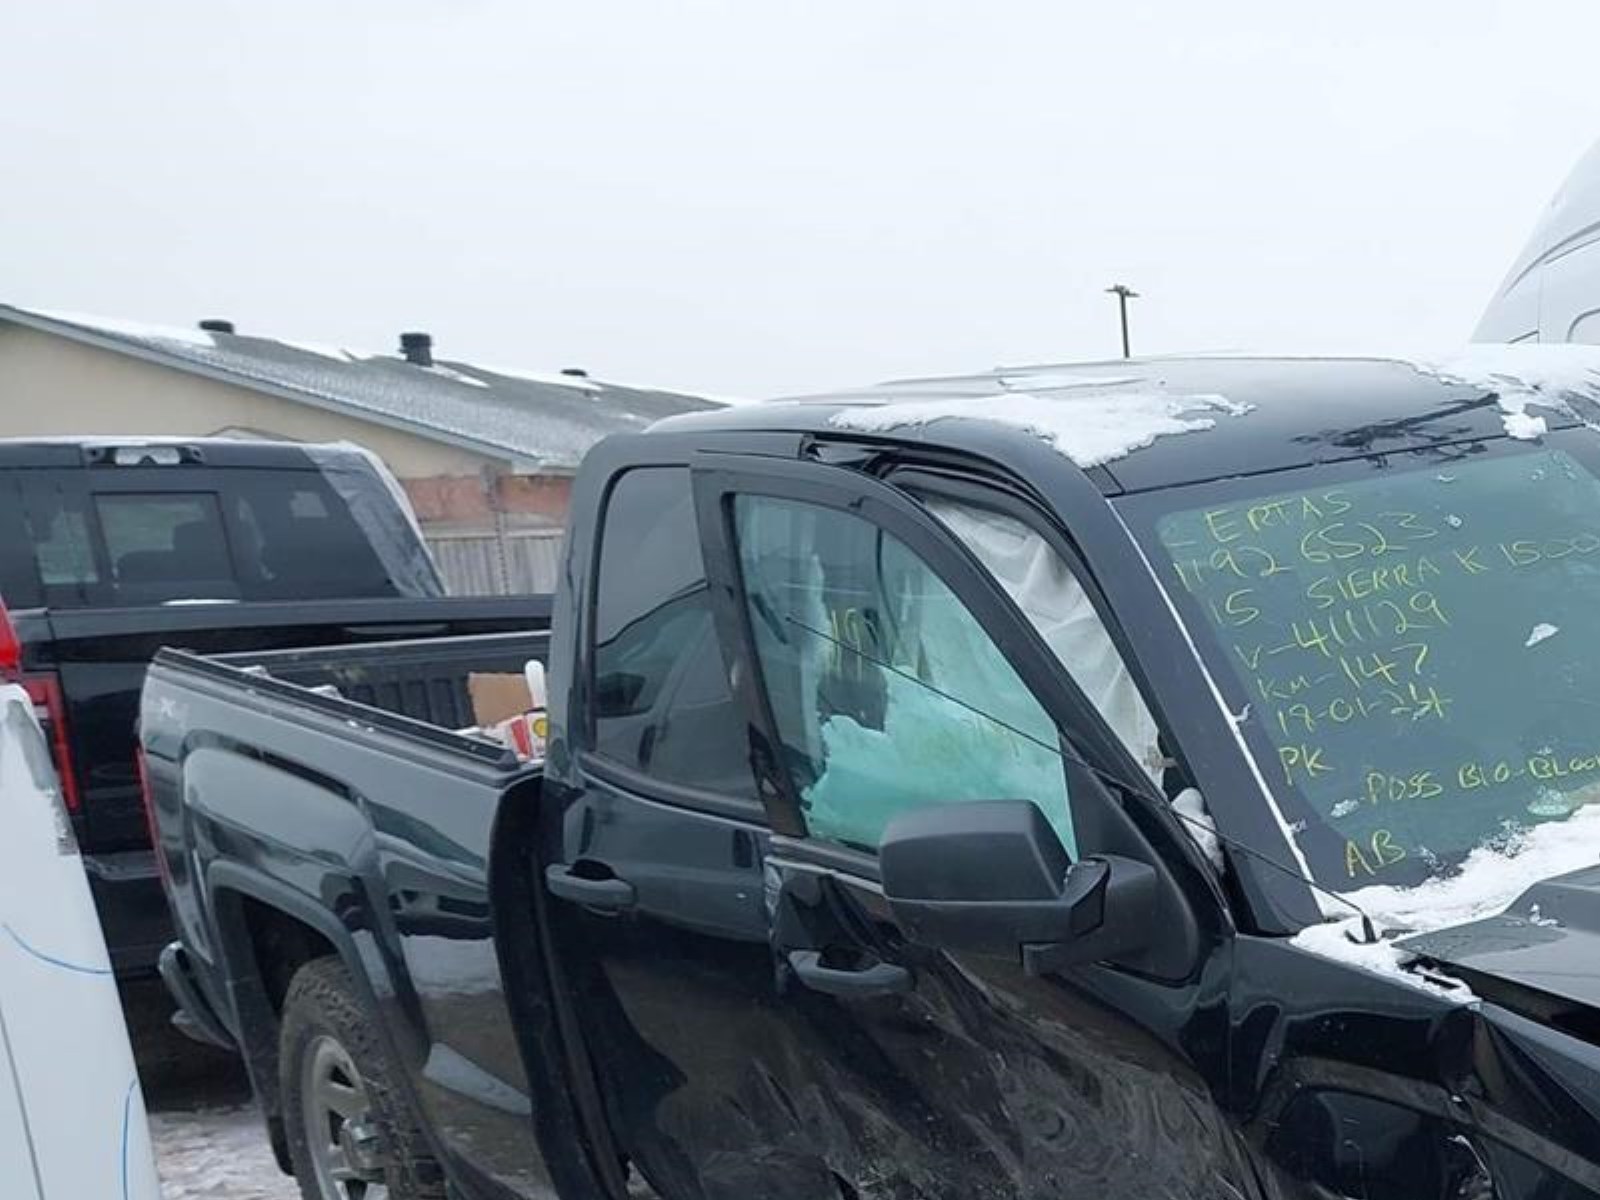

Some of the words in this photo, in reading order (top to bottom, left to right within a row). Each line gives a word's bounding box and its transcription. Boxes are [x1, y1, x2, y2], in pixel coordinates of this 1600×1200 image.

[1307, 556, 1440, 610] SIERRA
[1452, 544, 1489, 575] K
[1279, 744, 1336, 786] PK
[1345, 829, 1407, 878] AB
